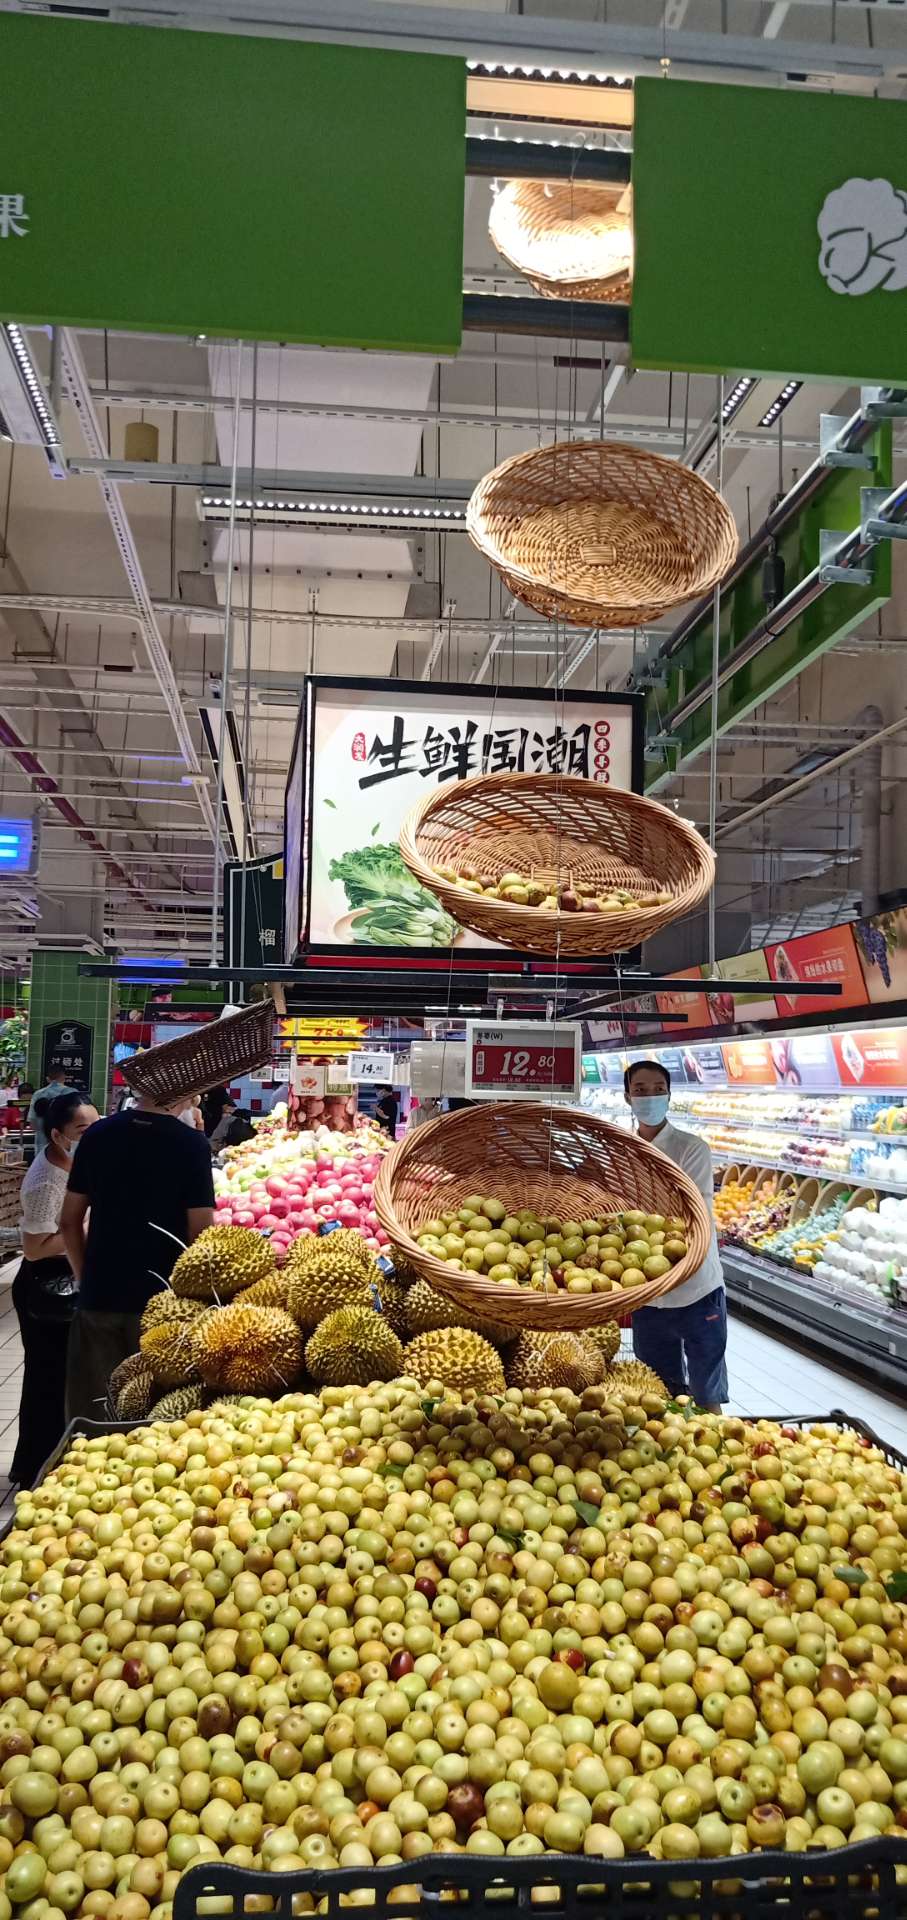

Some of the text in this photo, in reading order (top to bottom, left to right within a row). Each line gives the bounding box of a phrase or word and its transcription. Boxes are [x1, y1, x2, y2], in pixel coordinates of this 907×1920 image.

[358, 715, 591, 790] 生鲜国潮
[499, 1050, 556, 1076] 12.80
